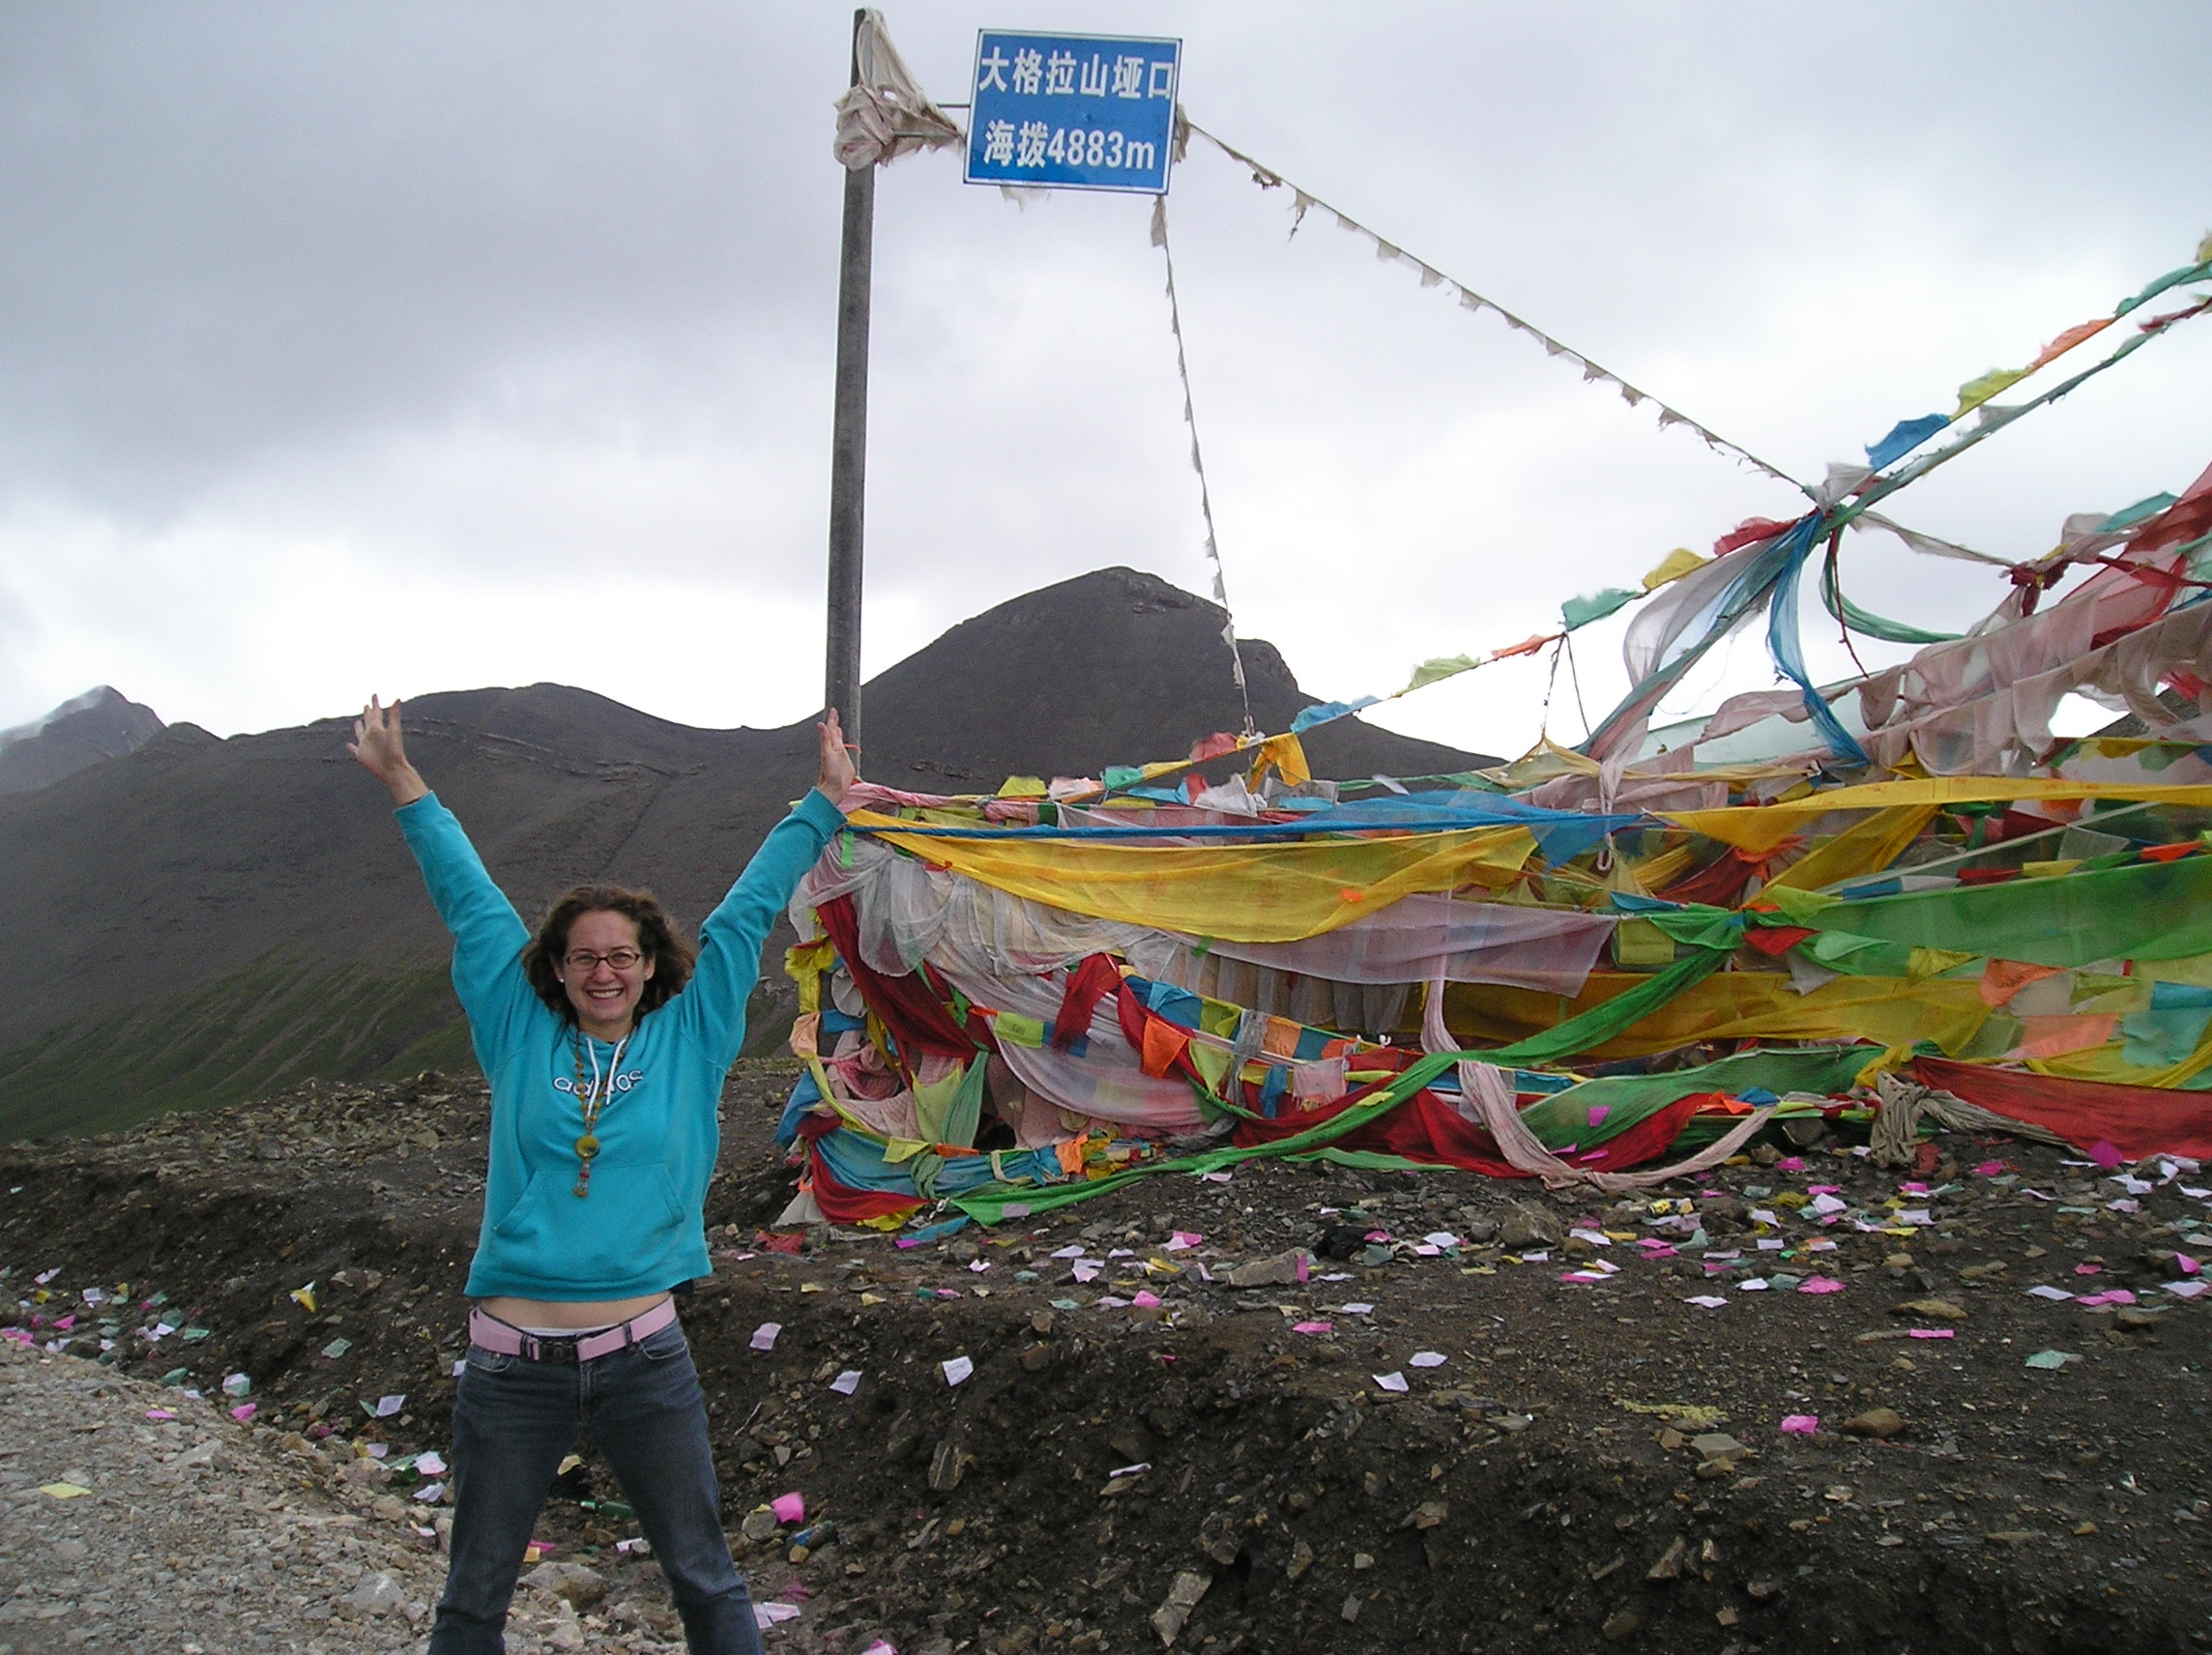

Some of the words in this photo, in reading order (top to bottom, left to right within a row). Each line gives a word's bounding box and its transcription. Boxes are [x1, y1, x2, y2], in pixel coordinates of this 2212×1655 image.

[978, 46, 1174, 100] 大格拉山垭口
[553, 1069, 644, 1097] adas
